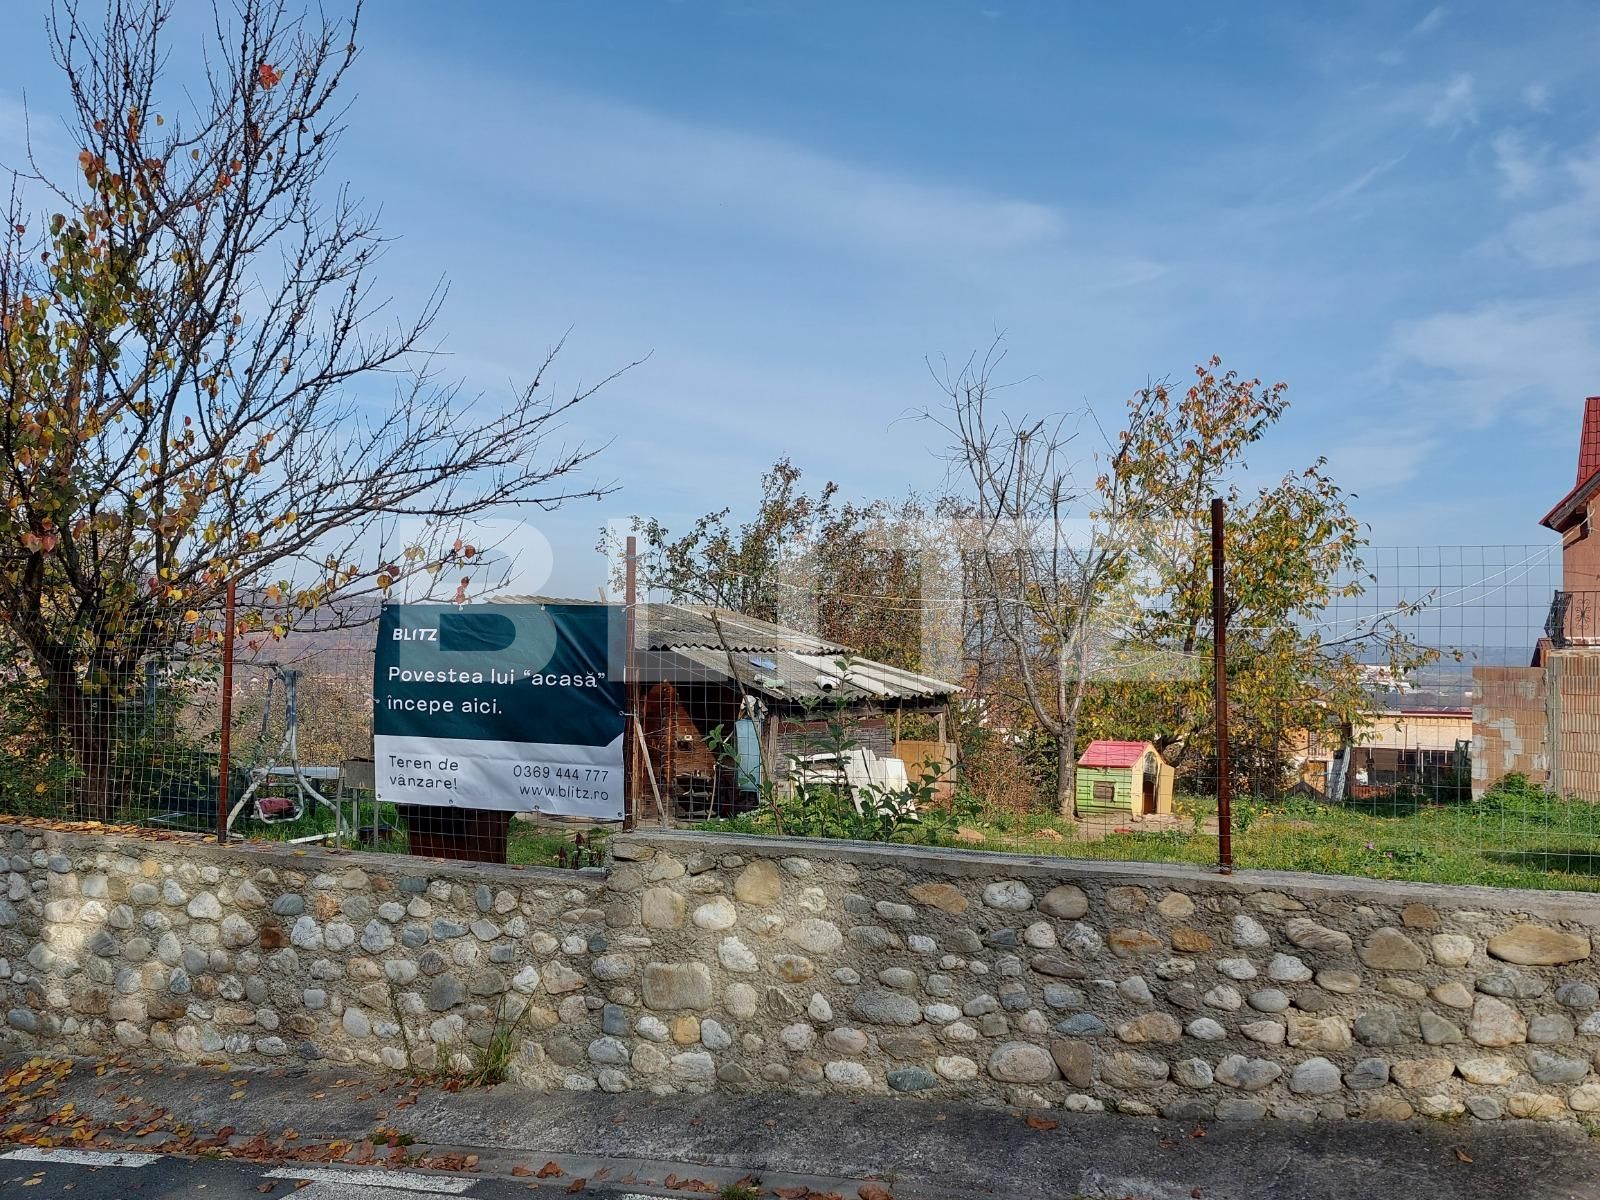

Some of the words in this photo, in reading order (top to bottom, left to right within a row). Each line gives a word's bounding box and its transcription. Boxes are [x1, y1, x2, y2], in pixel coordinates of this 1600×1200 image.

[392, 628, 438, 642] BLITZ
[388, 666, 484, 684] Povestea
[490, 669, 515, 685] lui
[387, 694, 454, 716] începe
[461, 698, 502, 715] aici.
[388, 755, 432, 770] Teren
[438, 757, 459, 771] de
[389, 774, 458, 790] vânzare!
[513, 764, 551, 779] 0369
[555, 767, 580, 781] 444
[584, 769, 609, 783] 777
[519, 784, 609, 801] www.blitz.ro
